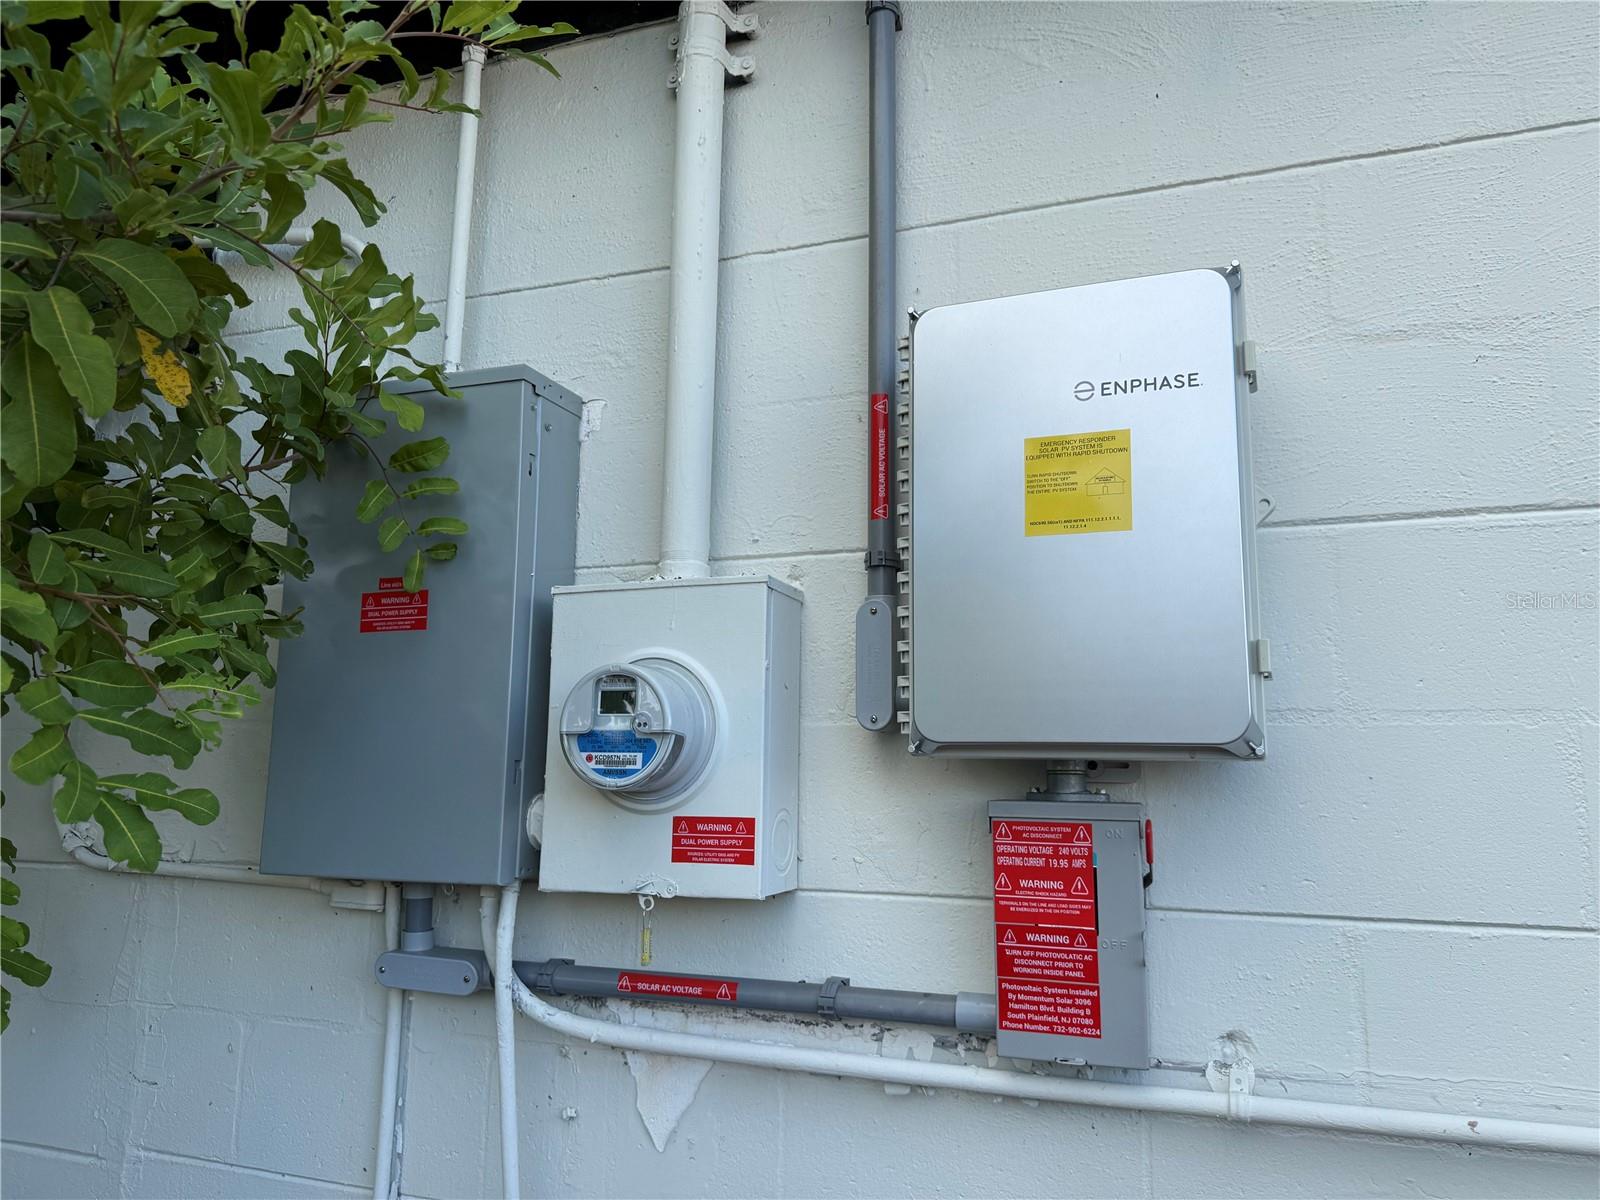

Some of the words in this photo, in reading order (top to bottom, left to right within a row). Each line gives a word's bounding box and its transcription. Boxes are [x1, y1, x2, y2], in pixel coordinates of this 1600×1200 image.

[1101, 372, 1200, 396] ENPHASE
[1041, 440, 1078, 448] EMERGENCY
[1079, 436, 1116, 444] RESPONDER
[1026, 453, 1055, 461] EQUIPPED
[1073, 449, 1091, 457] RAPID
[1092, 447, 1128, 455] SHUTDOWN
[879, 462, 886, 472] AC
[381, 596, 410, 605] WARNING
[381, 609, 399, 617] POWER
[400, 608, 418, 616] SUPPLY
[697, 823, 733, 832] WARNING
[698, 838, 719, 846] POWER
[996, 845, 1029, 854] OPERATING
[1029, 846, 1054, 855] VOLTAGE
[1059, 847, 1070, 855] 240
[1071, 847, 1089, 856] VOLTS
[997, 856, 1024, 866] OPERATING
[1024, 857, 1046, 867] CURRENT
[1049, 858, 1069, 868] 19.95
[1072, 859, 1087, 868] AMPS
[1020, 879, 1064, 890] WARNING
[1026, 932, 1070, 944] WARNING
[1036, 951, 1083, 960] PHOTOVOLATIC
[1014, 958, 1053, 967] DISCONNECT
[1055, 961, 1074, 969] PRIOR
[1013, 966, 1042, 975] WORKING
[1065, 970, 1086, 978] PANEL
[637, 982, 660, 991] SOLAR
[672, 985, 703, 995] VOLTAGE
[1002, 982, 1042, 993] Photovoltaic
[1043, 986, 1068, 996] System
[1069, 988, 1098, 997] Installed
[1008, 993, 1016, 1001] By
[1018, 993, 1055, 1003] Momentum
[1009, 1002, 1038, 1011] Hamilton
[1057, 1006, 1084, 1016] Building
[1008, 1011, 1026, 1020] South
[1028, 1013, 1060, 1023] Plainfield,
[1073, 1017, 1094, 1025] 07080
[1003, 1020, 1023, 1029] Phone
[1053, 1025, 1100, 1036] 732-902-6224
